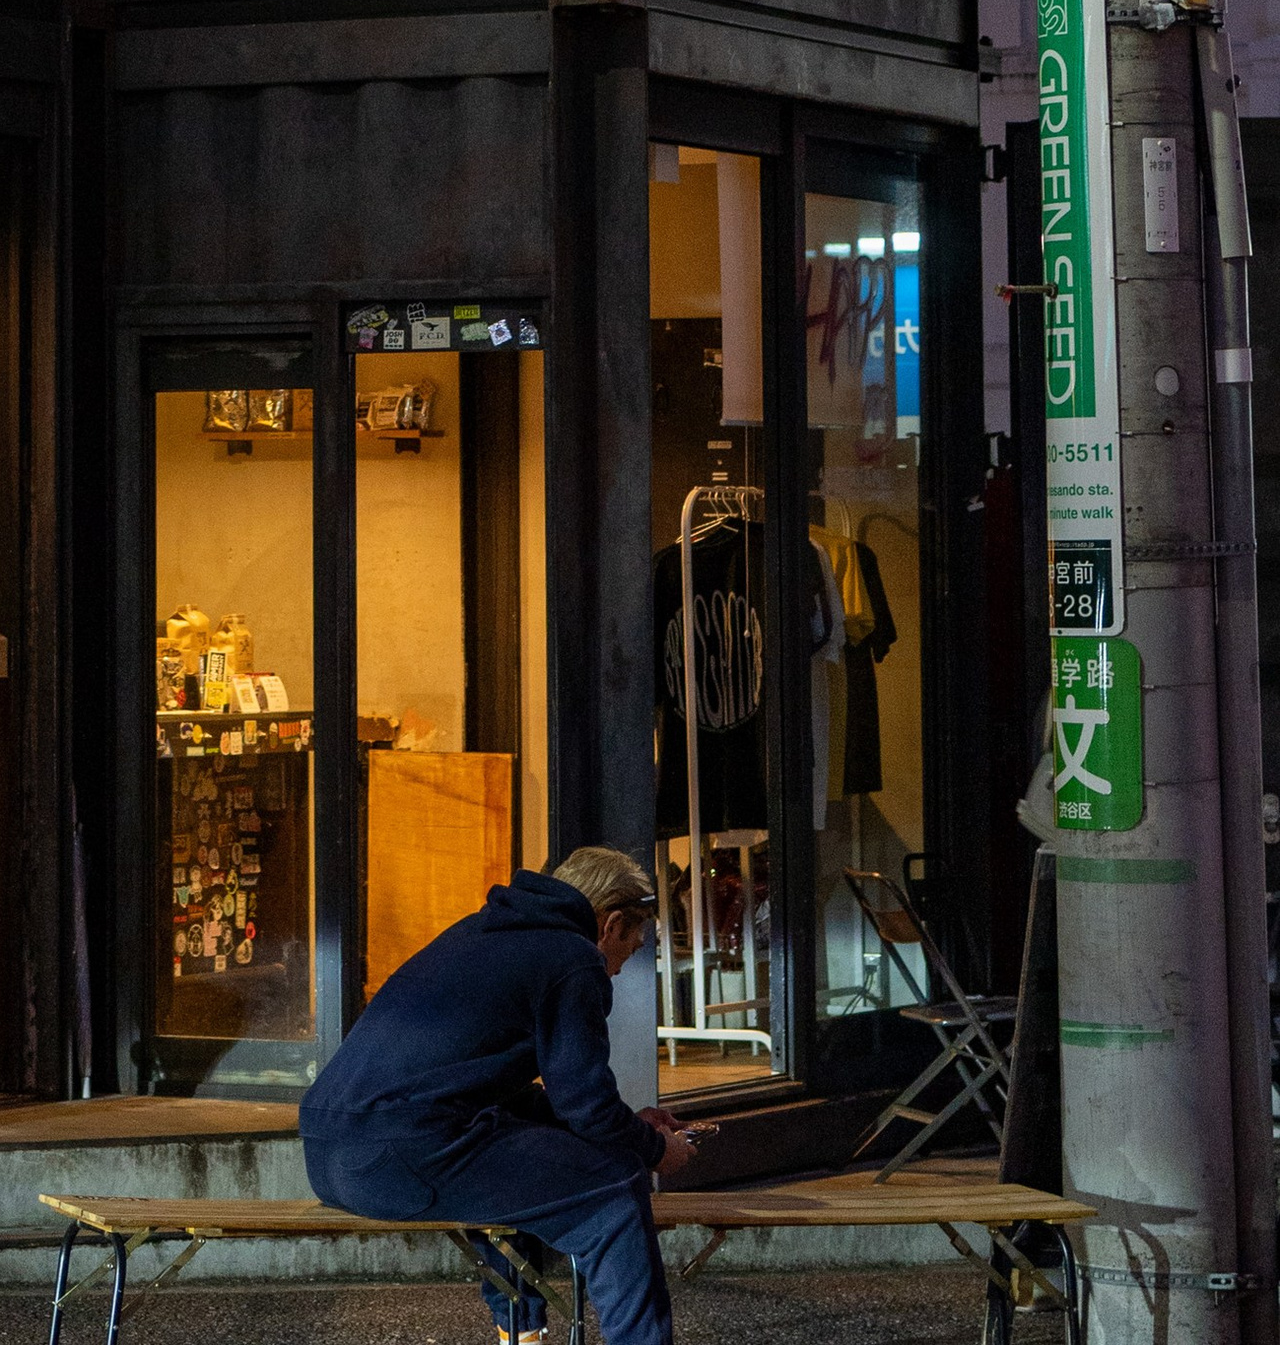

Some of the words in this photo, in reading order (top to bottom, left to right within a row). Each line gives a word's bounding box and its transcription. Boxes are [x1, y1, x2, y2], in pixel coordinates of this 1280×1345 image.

[1039, 48, 1072, 242] GREEN
[1088, 483, 1114, 496] sta.
[1082, 506, 1114, 520] walk
